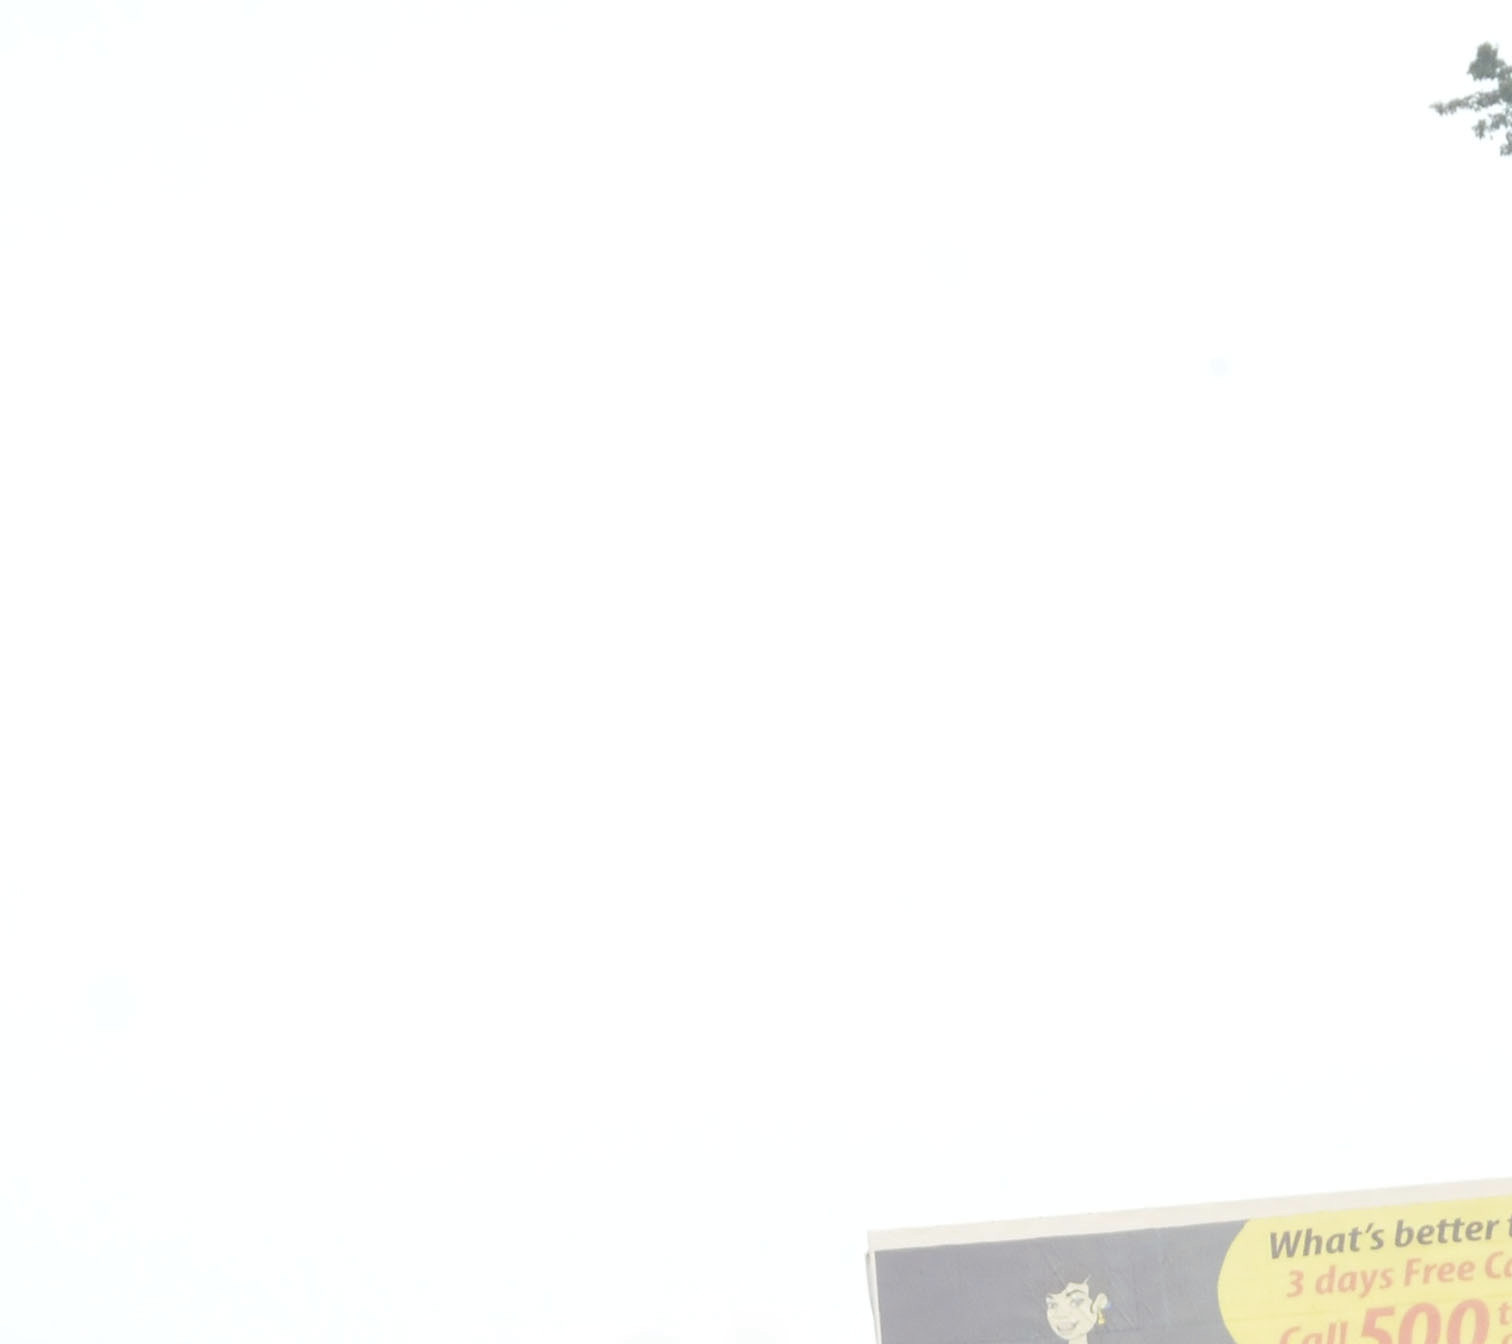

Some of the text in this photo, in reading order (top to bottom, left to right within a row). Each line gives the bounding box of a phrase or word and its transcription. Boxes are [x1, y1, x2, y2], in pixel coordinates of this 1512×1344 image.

[1394, 1217, 1500, 1248] better
[1286, 1270, 1304, 1298] 3
[1315, 1265, 1393, 1298] days
[1403, 1257, 1475, 1288] Free
